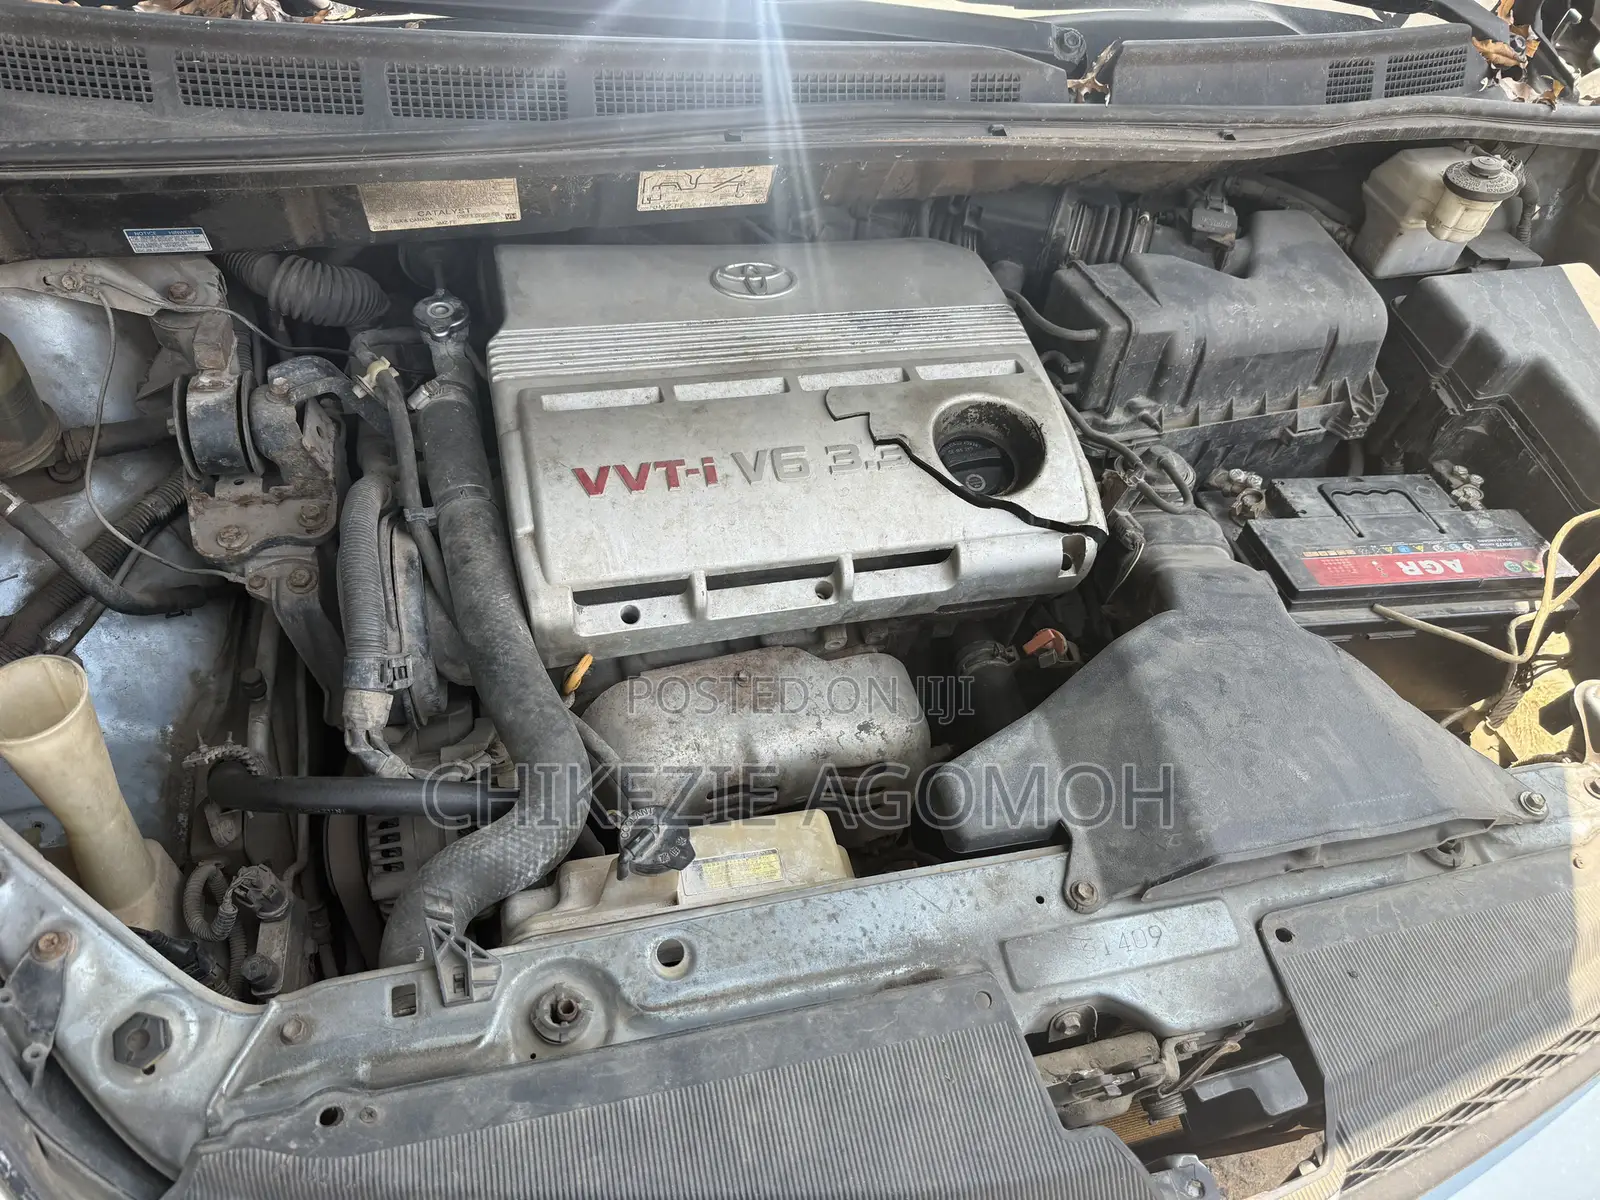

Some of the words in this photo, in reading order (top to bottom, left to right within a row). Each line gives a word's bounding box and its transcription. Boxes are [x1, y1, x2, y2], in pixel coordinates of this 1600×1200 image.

[417, 207, 472, 217] CATALYST
[571, 456, 720, 498] VVT-i
[730, 445, 811, 484] V6
[1394, 558, 1465, 576] AGR
[620, 806, 656, 839] COOLANT
